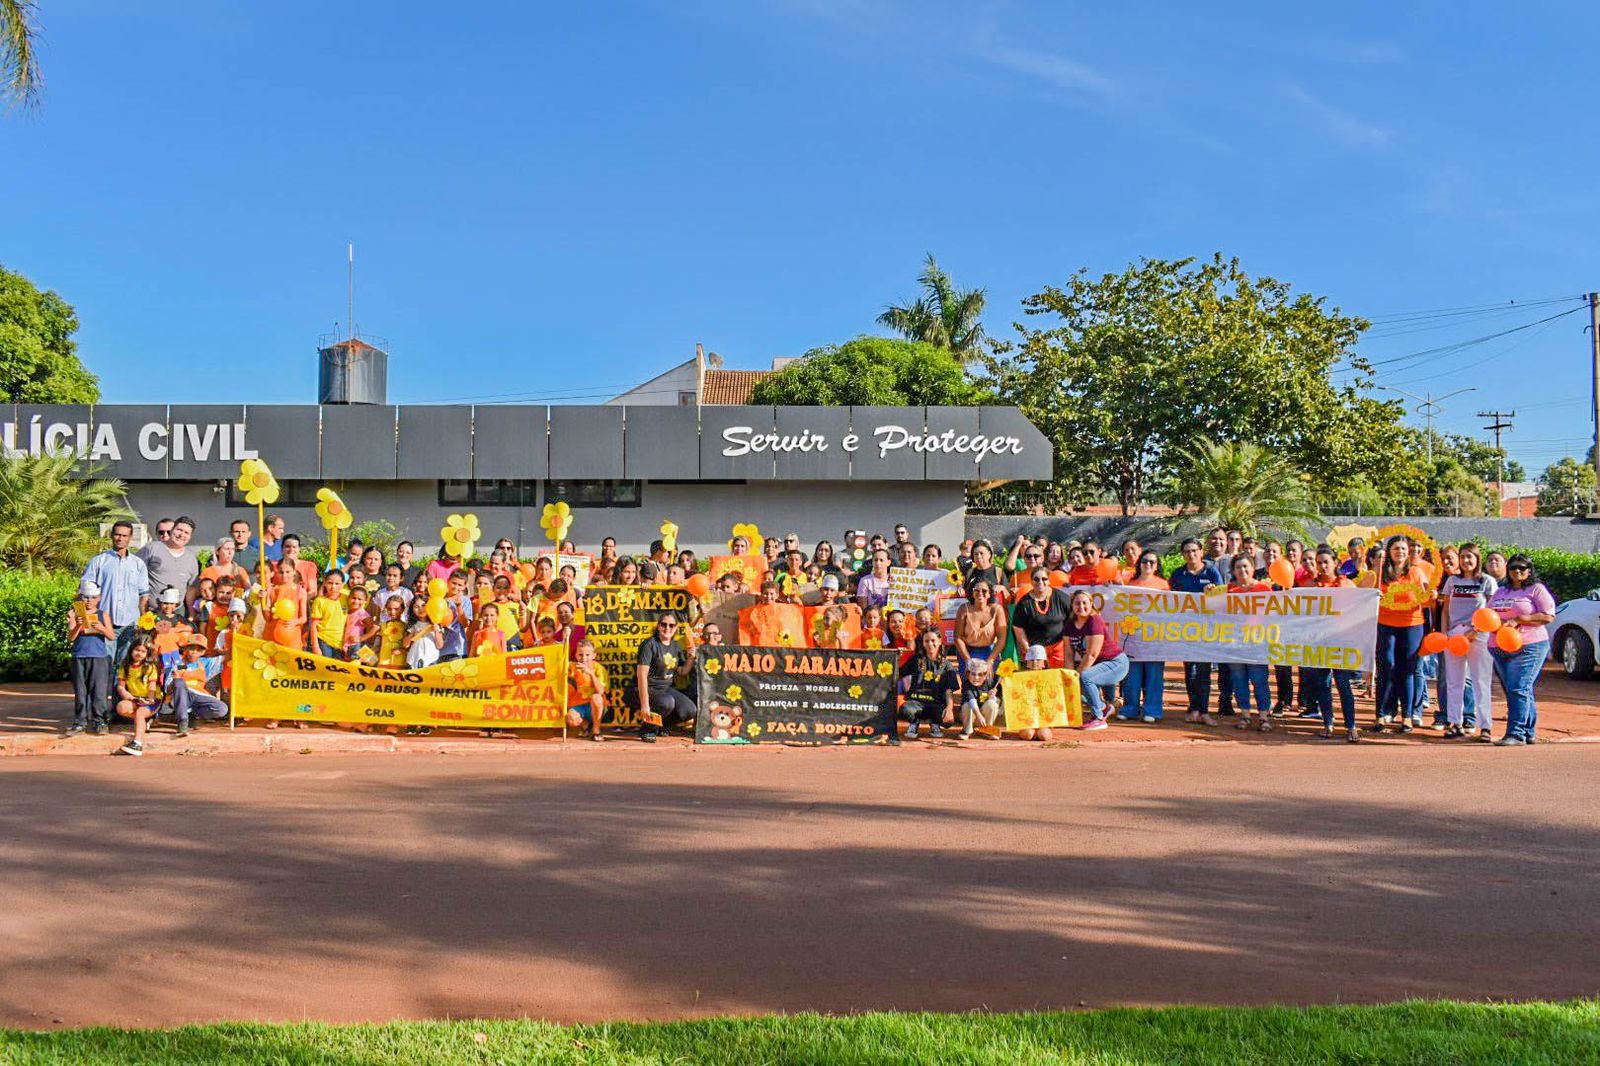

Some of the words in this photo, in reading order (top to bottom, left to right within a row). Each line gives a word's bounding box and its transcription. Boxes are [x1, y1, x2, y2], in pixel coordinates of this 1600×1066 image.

[138, 422, 259, 461] CIVIL
[722, 426, 829, 457] Servir
[873, 425, 1024, 464] Proteger
[583, 592, 605, 615] 18
[632, 591, 688, 611] MAIO
[1112, 591, 1216, 615] SEXUAL
[1226, 594, 1343, 616] INFANTIL
[586, 623, 641, 636] ABUSO
[1141, 621, 1234, 643] DISQUE
[1239, 623, 1281, 644] 100
[599, 639, 619, 648] VAI
[511, 656, 545, 665] DISQUE
[723, 653, 776, 673] MAIO
[784, 654, 875, 678] LARANJA
[1267, 642, 1363, 670] SEMED
[294, 656, 316, 671] 18
[325, 664, 350, 674] de
[357, 667, 424, 683] MAIO
[513, 667, 529, 676] 100
[270, 678, 336, 691] COMBATE
[347, 682, 366, 692] AO
[374, 684, 421, 695] ABUSO
[429, 687, 492, 700] INFANTIL
[500, 685, 556, 704] FAÇA
[759, 683, 799, 691] PROTEJA
[806, 684, 840, 693] NOSSAS
[365, 708, 395, 718] CRAS
[482, 703, 561, 721] BONITO
[754, 700, 798, 710] CRIANÇAS
[813, 702, 879, 713] ADOLESCENTES
[766, 721, 808, 735] FAÇA
[815, 723, 875, 736] BONITO
